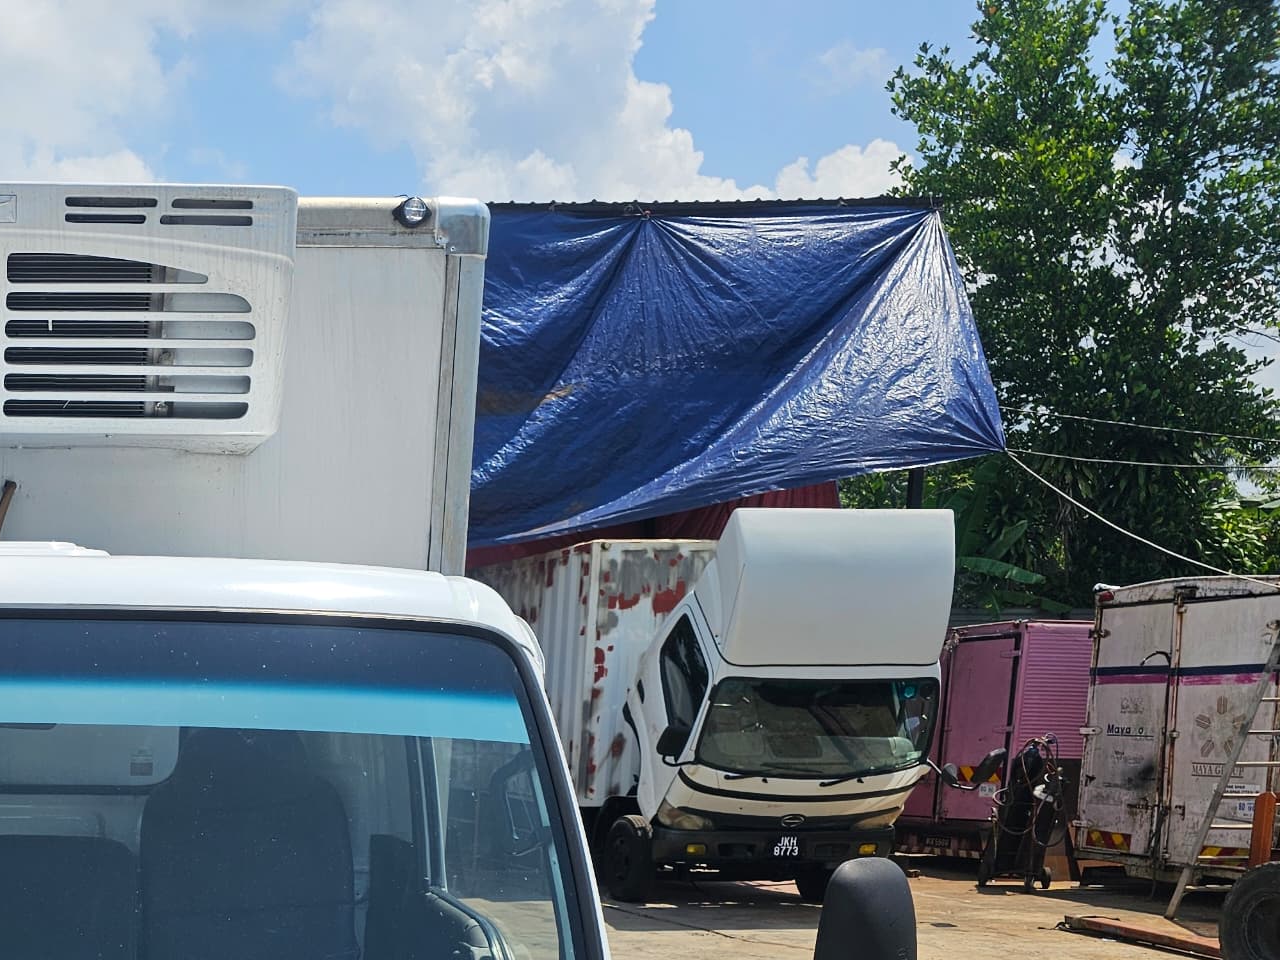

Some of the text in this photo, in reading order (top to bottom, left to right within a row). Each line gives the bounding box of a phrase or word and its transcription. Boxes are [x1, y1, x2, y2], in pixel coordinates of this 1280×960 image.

[1192, 764, 1213, 775] MAYA
[777, 836, 797, 846] JKH
[773, 846, 799, 856] 8773
